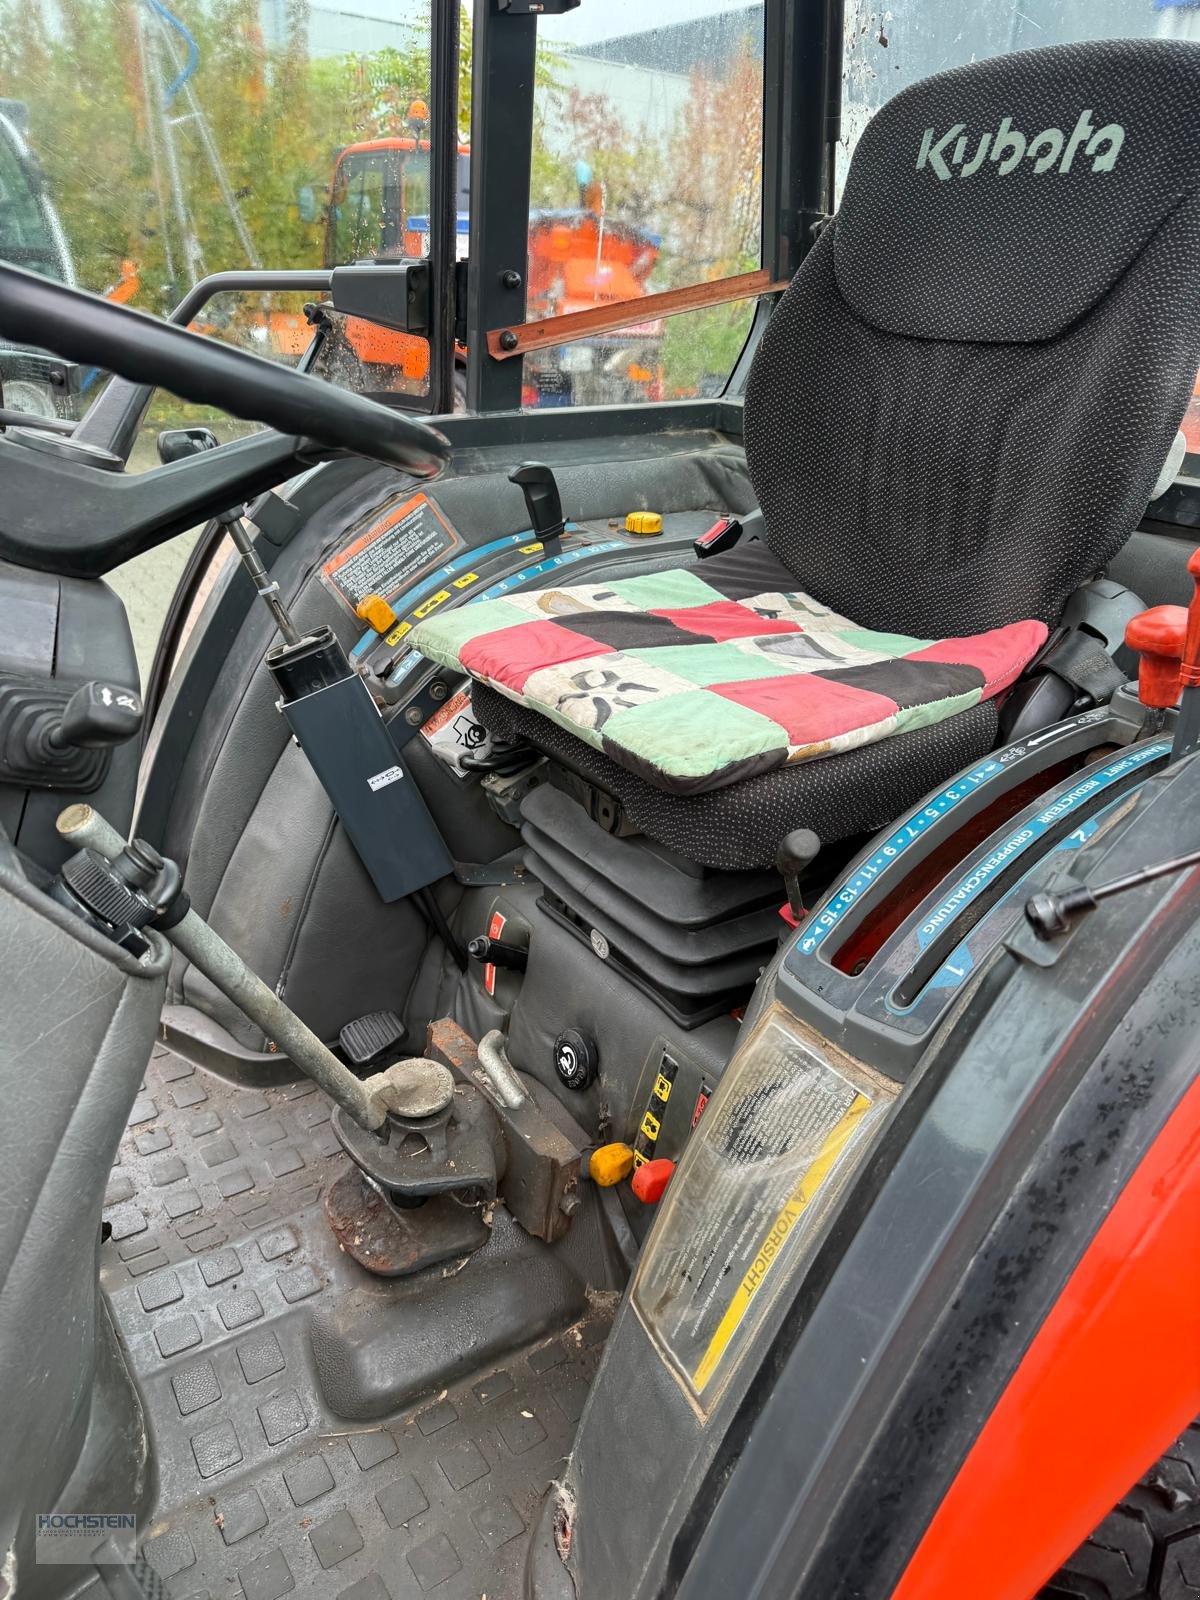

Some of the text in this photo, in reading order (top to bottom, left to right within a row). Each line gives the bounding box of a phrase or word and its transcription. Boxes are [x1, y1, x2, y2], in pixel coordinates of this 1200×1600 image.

[915, 109, 1125, 180] Kubota
[443, 535, 521, 575] N 2
[945, 790, 960, 800] 3
[925, 808, 940, 818] 5
[905, 826, 919, 838] 7
[1070, 828, 1087, 843] 2
[923, 745, 1166, 935] RANGE SHIFT REDUCTEUR GRUPPENSCHALTUNG
[883, 846, 897, 856] 9
[861, 865, 878, 879] 11
[839, 887, 857, 903] 13
[820, 910, 838, 927] 15
[945, 965, 966, 977] 1
[743, 1208, 797, 1296] VORSICHT
